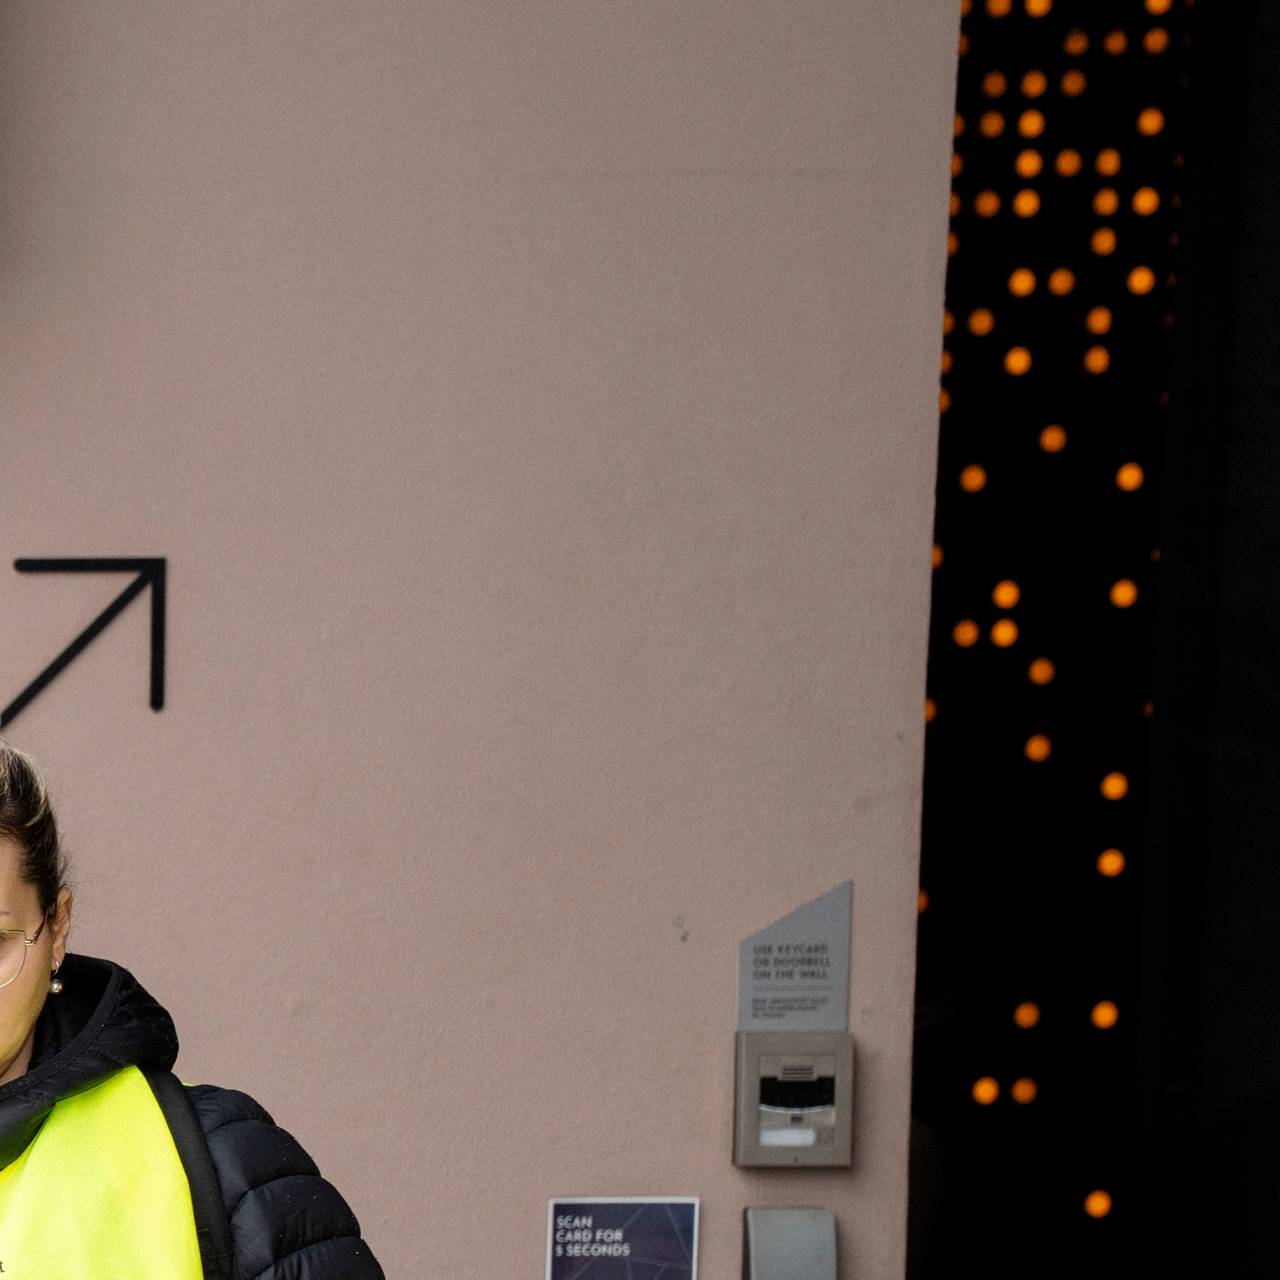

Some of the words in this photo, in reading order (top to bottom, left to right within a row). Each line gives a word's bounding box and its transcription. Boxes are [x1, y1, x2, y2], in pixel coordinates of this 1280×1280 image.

[556, 1214, 593, 1229] SCAN
[555, 1229, 592, 1243] CARD
[595, 1228, 623, 1242] FOR
[566, 1242, 630, 1257] SECONDS
